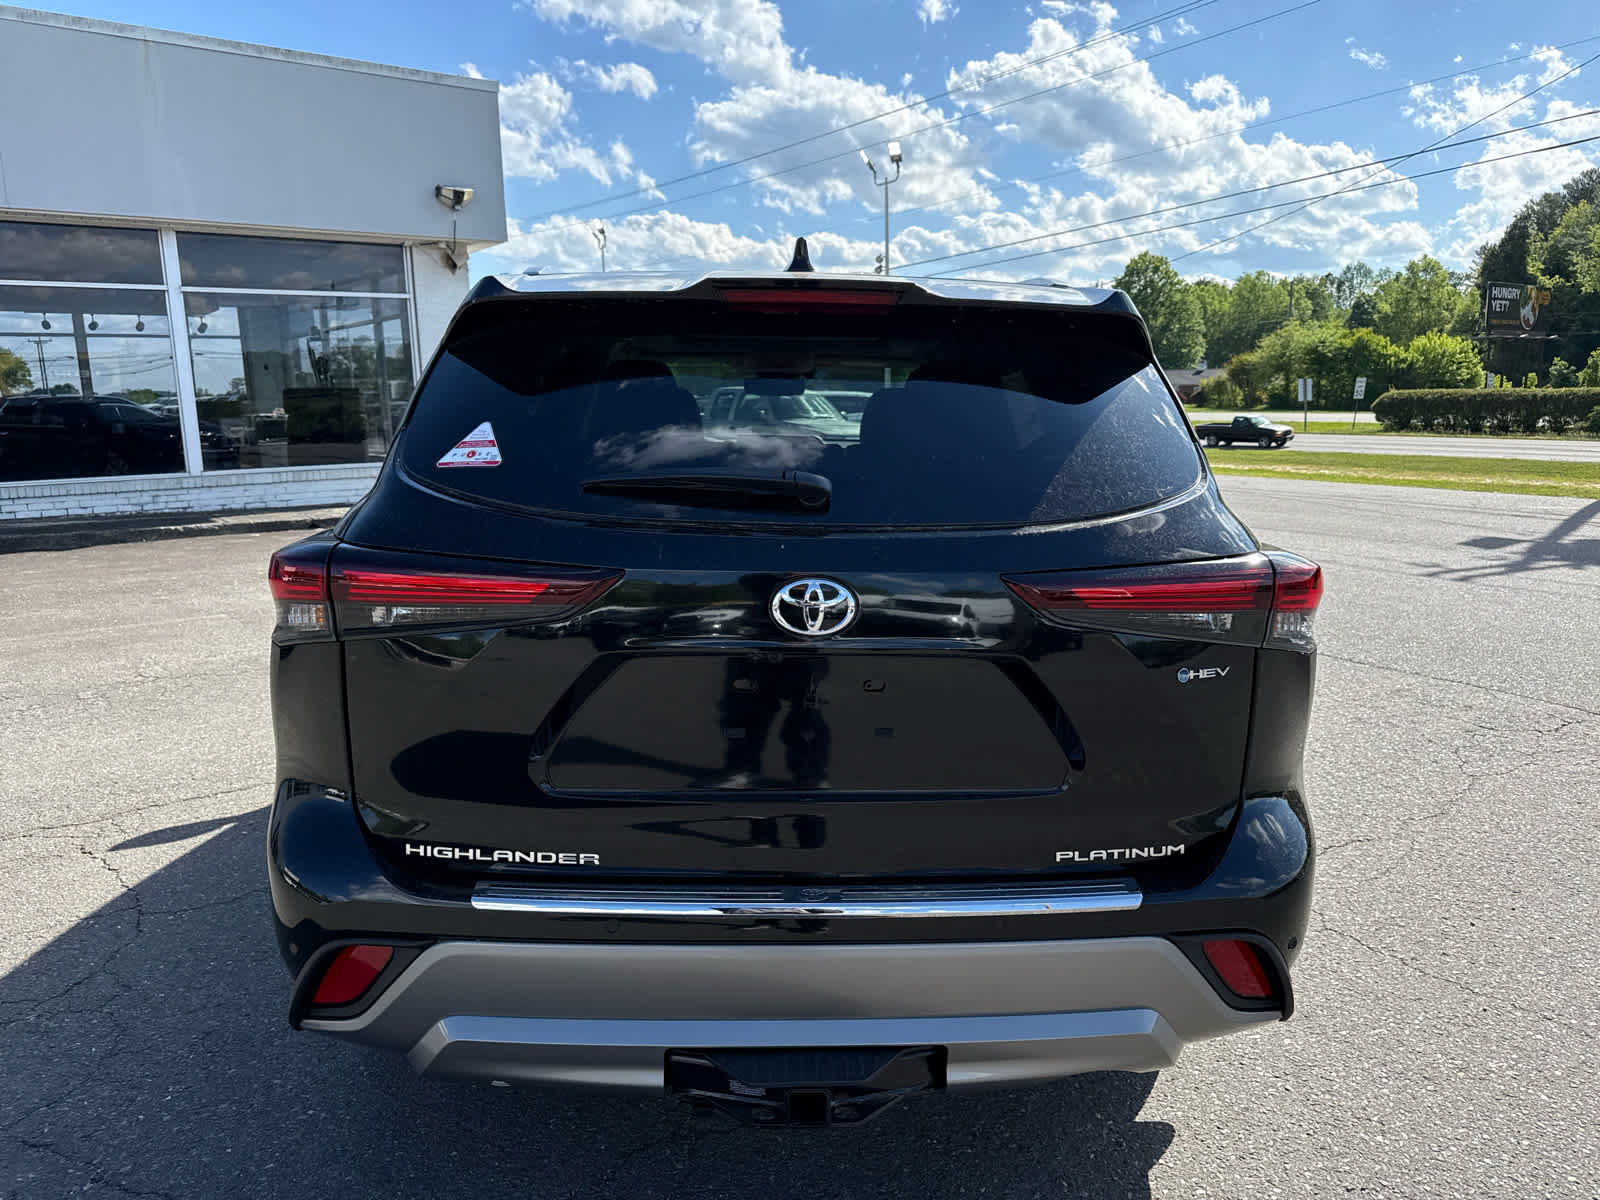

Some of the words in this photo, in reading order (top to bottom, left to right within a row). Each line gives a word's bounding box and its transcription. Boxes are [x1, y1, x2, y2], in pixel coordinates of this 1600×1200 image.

[1491, 287, 1520, 299] HUNGRY
[1491, 300, 1510, 312] YET?
[1189, 666, 1231, 679] HEV
[405, 844, 600, 865] HIGHLANDER
[1055, 844, 1185, 863] PLATINUM
